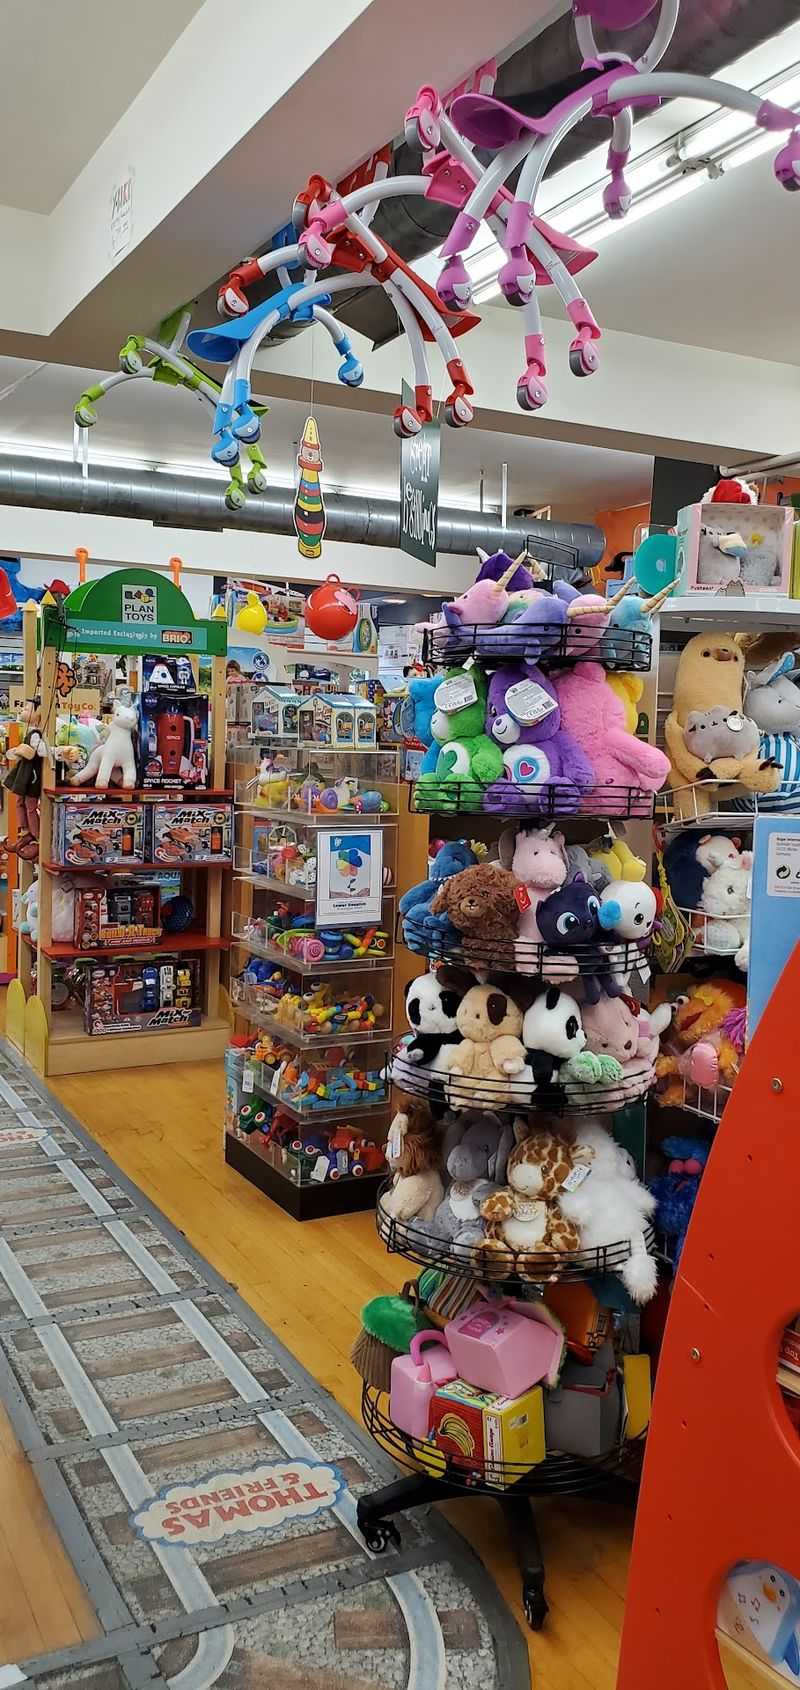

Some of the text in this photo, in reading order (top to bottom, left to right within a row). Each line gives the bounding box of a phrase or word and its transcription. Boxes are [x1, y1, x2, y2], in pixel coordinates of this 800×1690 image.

[124, 603, 154, 613] PLAN
[125, 612, 154, 622] TOYS
[62, 702, 81, 712] Toy
[82, 817, 122, 825] Match
[171, 816, 210, 824] Match
[149, 1015, 191, 1025] Match
[165, 1472, 300, 1515] & FRIENDS
[162, 1482, 328, 1536] THOMAS
